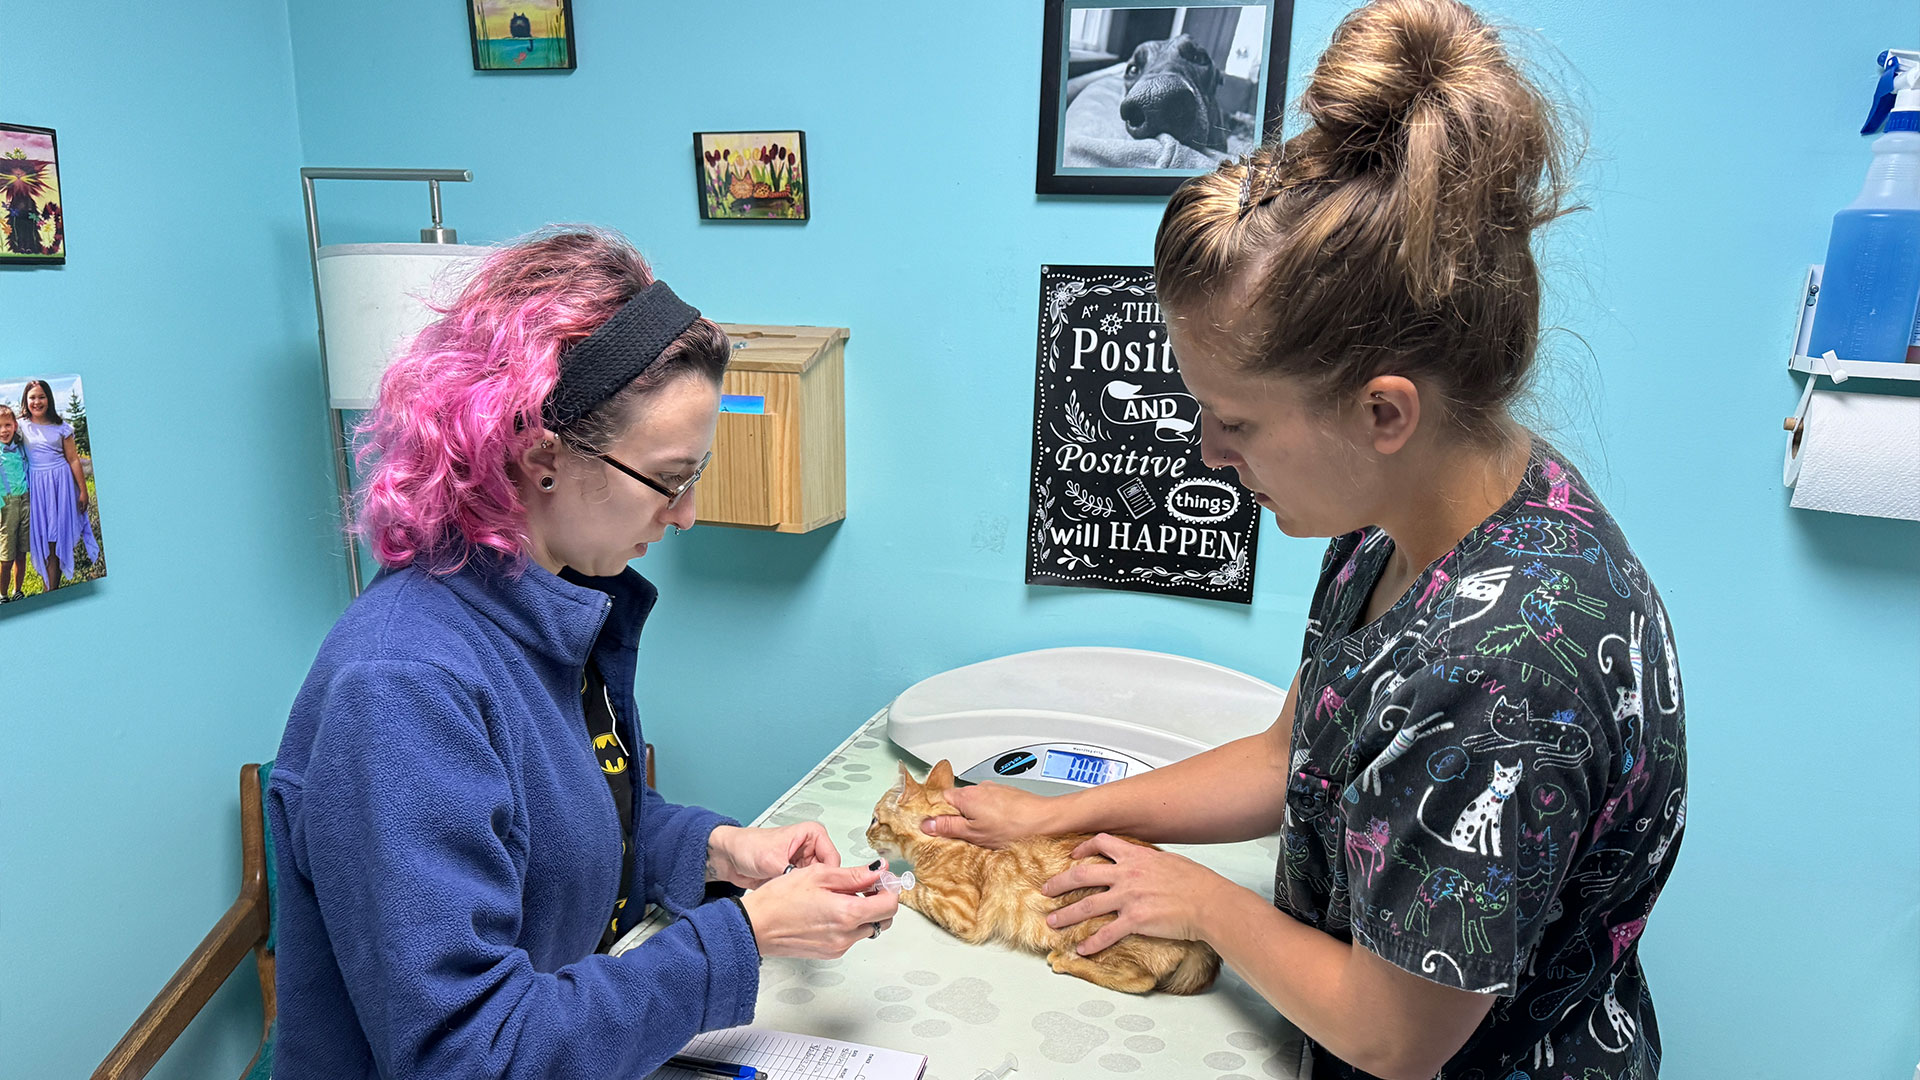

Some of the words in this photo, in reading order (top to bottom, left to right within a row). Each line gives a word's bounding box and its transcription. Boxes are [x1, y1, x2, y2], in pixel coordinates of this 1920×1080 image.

[1121, 302, 1167, 324] THI
[1070, 327, 1181, 374] Posit
[1123, 399, 1178, 421] AND
[1055, 443, 1187, 478] Positive
[1174, 493, 1232, 513] things
[1050, 523, 1100, 548] will
[1108, 521, 1242, 561] HAPPEN
